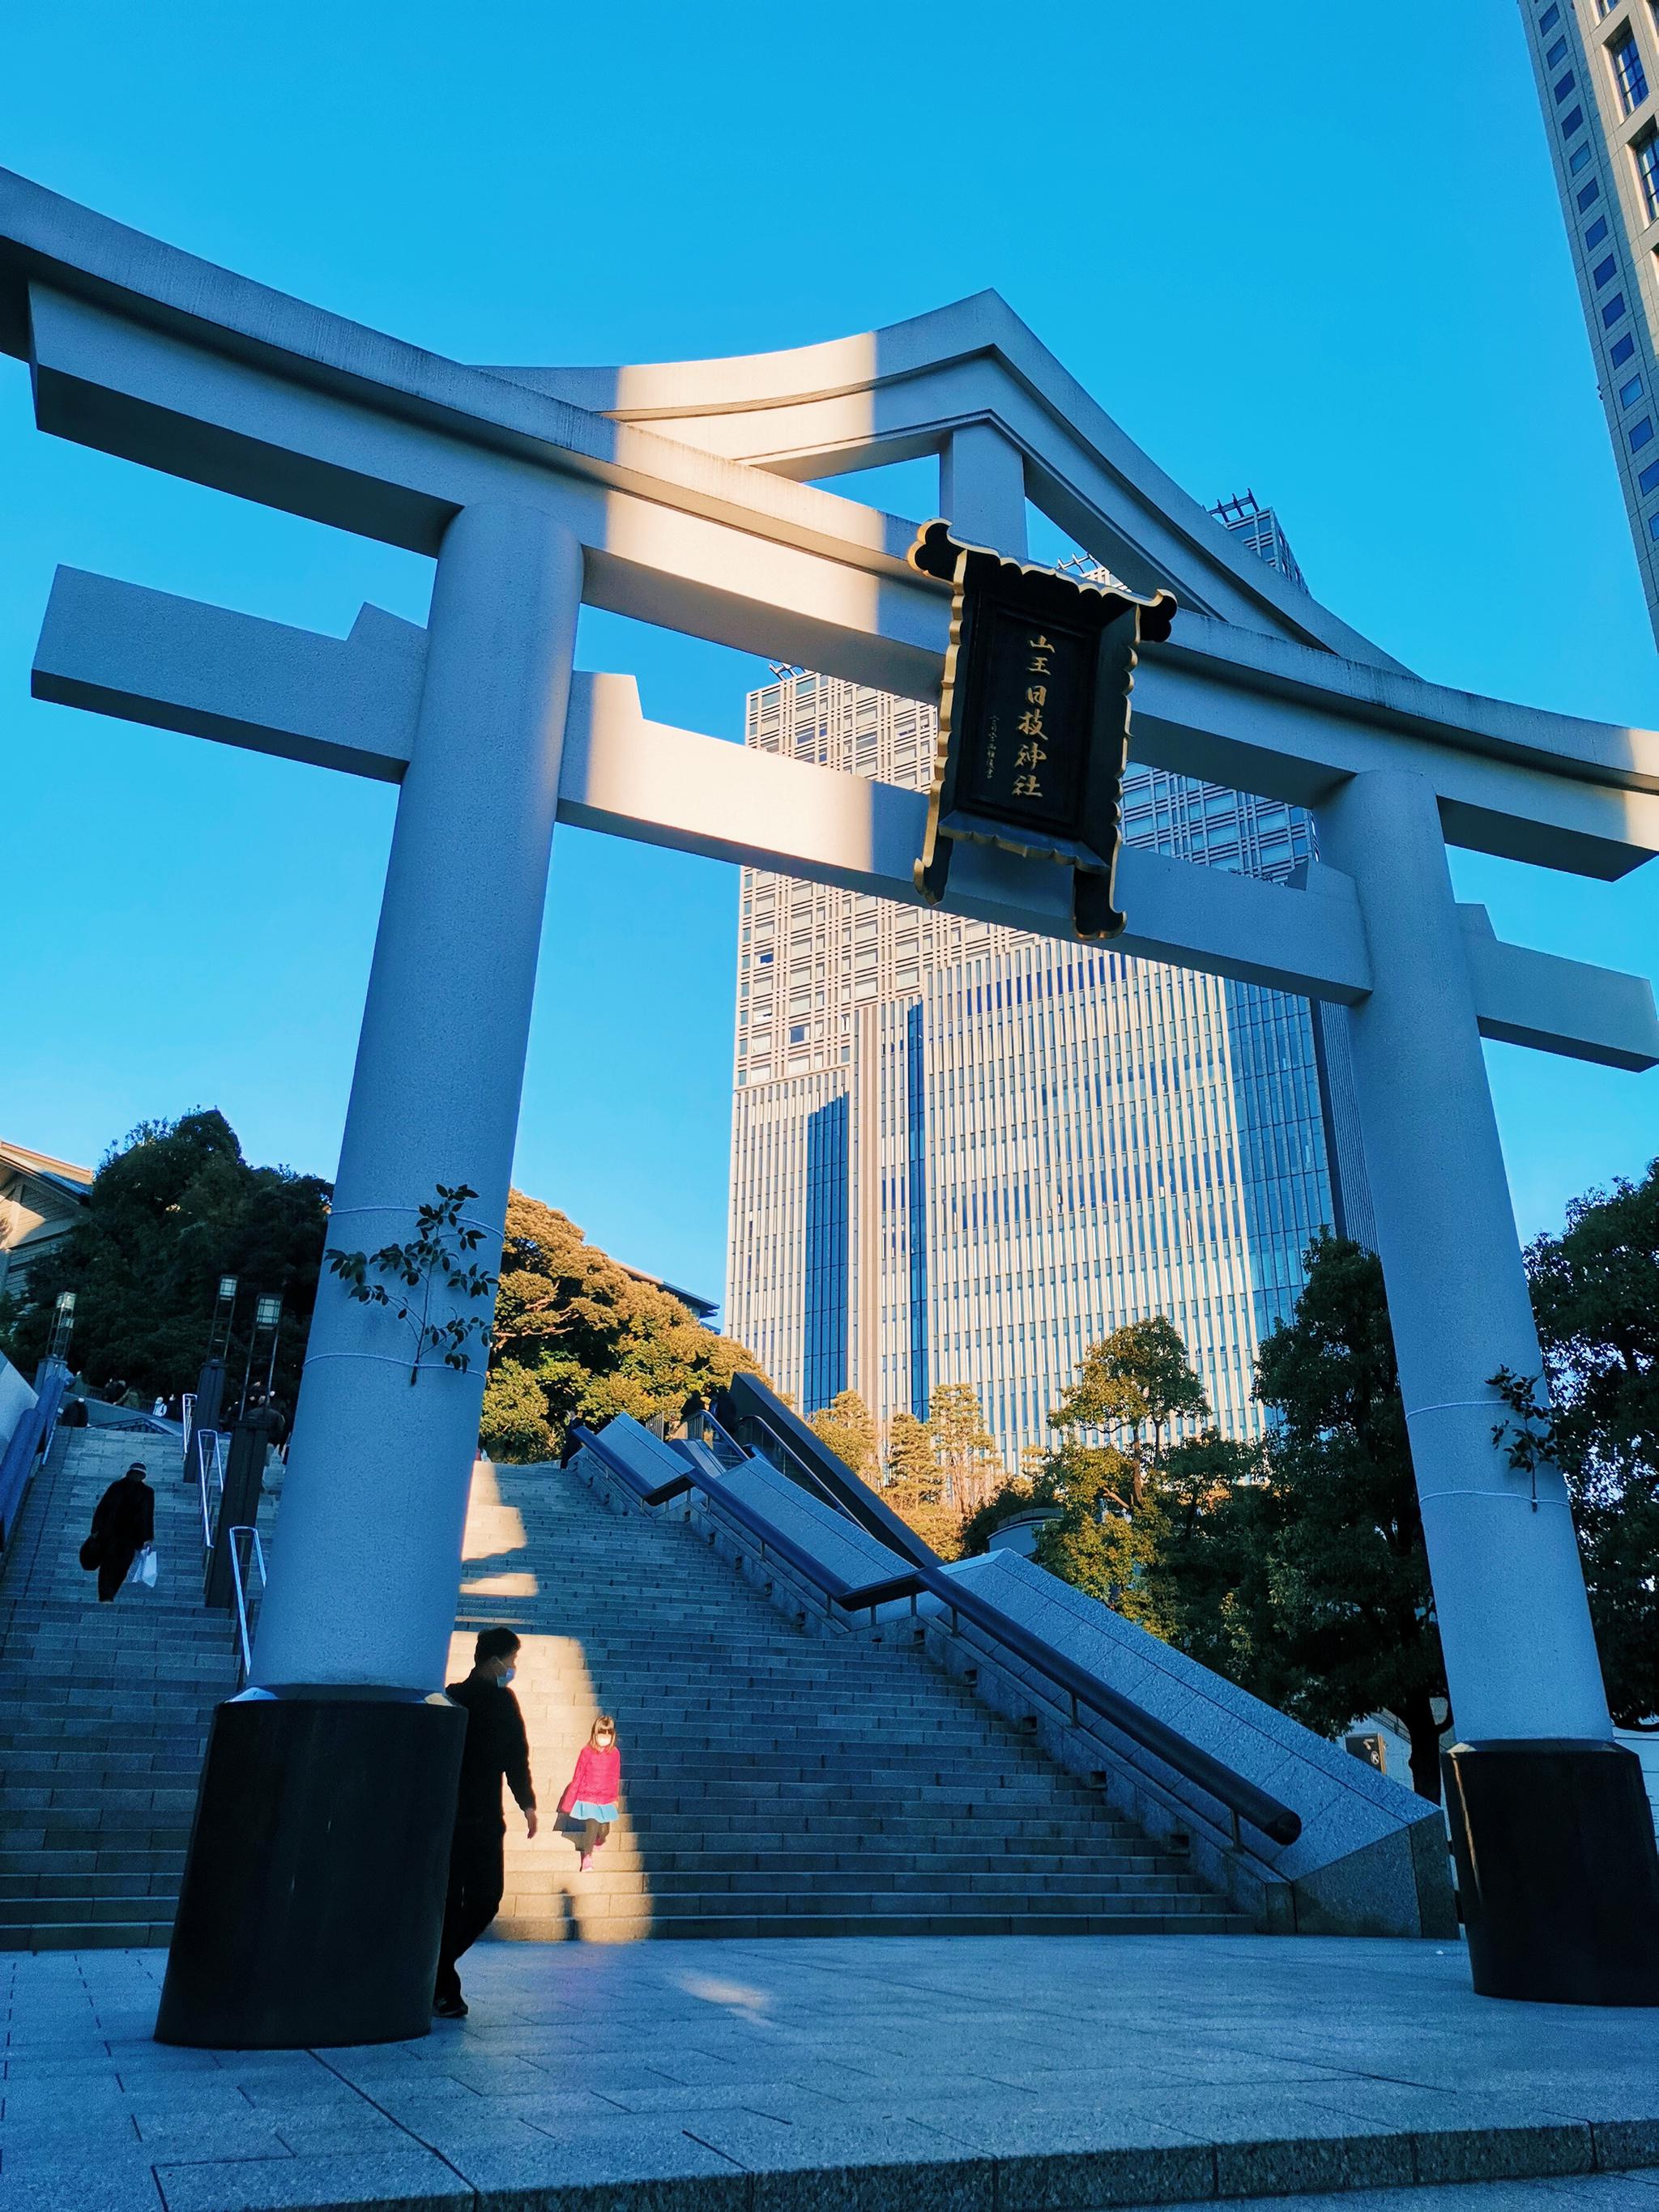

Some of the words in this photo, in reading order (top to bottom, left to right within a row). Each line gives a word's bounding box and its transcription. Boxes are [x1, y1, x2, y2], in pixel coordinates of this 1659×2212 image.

[1011, 634, 1056, 798] 山王日枝神社
